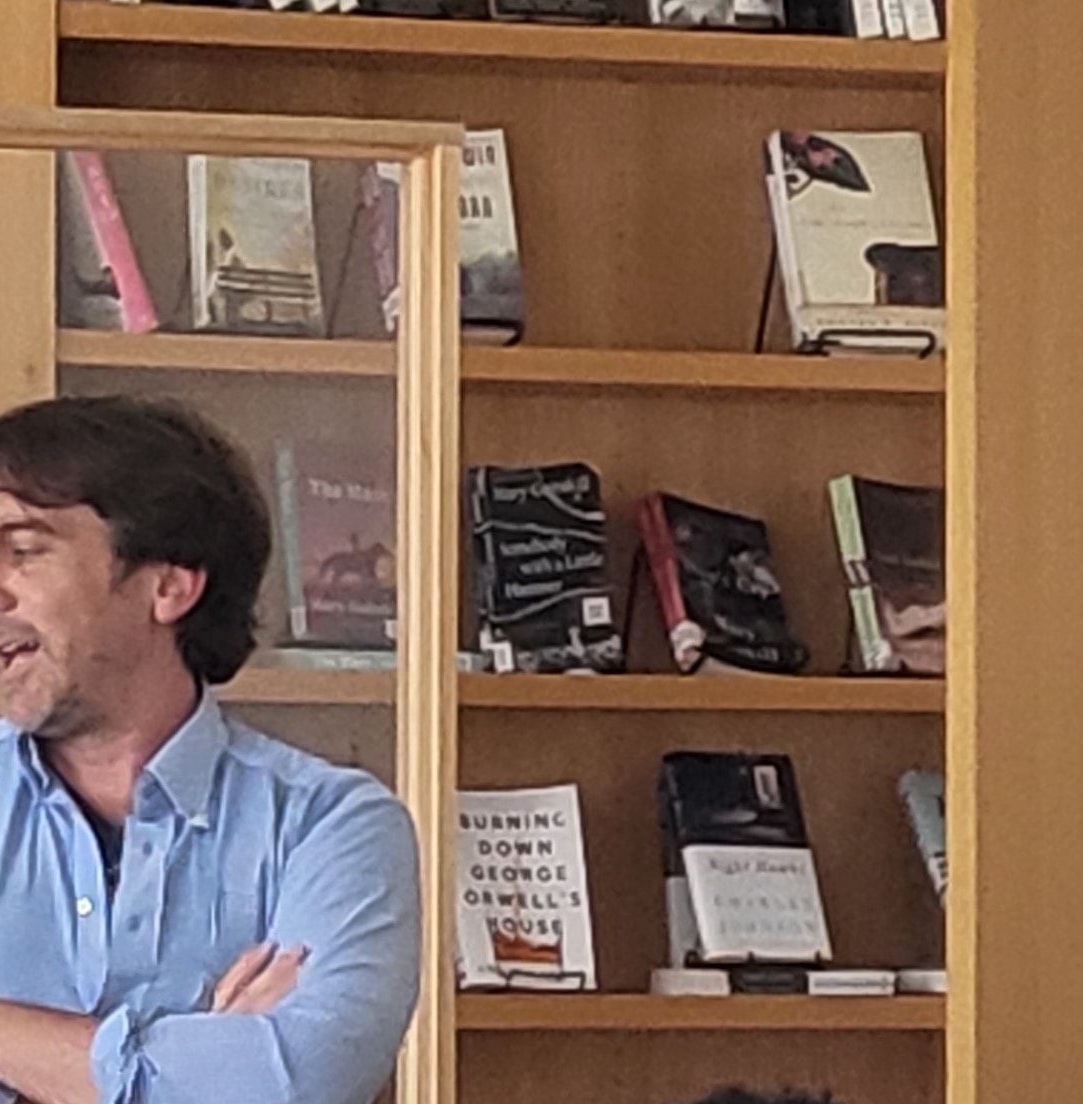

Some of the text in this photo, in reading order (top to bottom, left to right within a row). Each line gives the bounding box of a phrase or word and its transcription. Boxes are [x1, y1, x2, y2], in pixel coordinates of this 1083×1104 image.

[478, 839, 553, 857] DOWN
[470, 864, 567, 882] GEORGE
[463, 889, 581, 909] ORWELL'S
[485, 916, 563, 936] HOUSE
